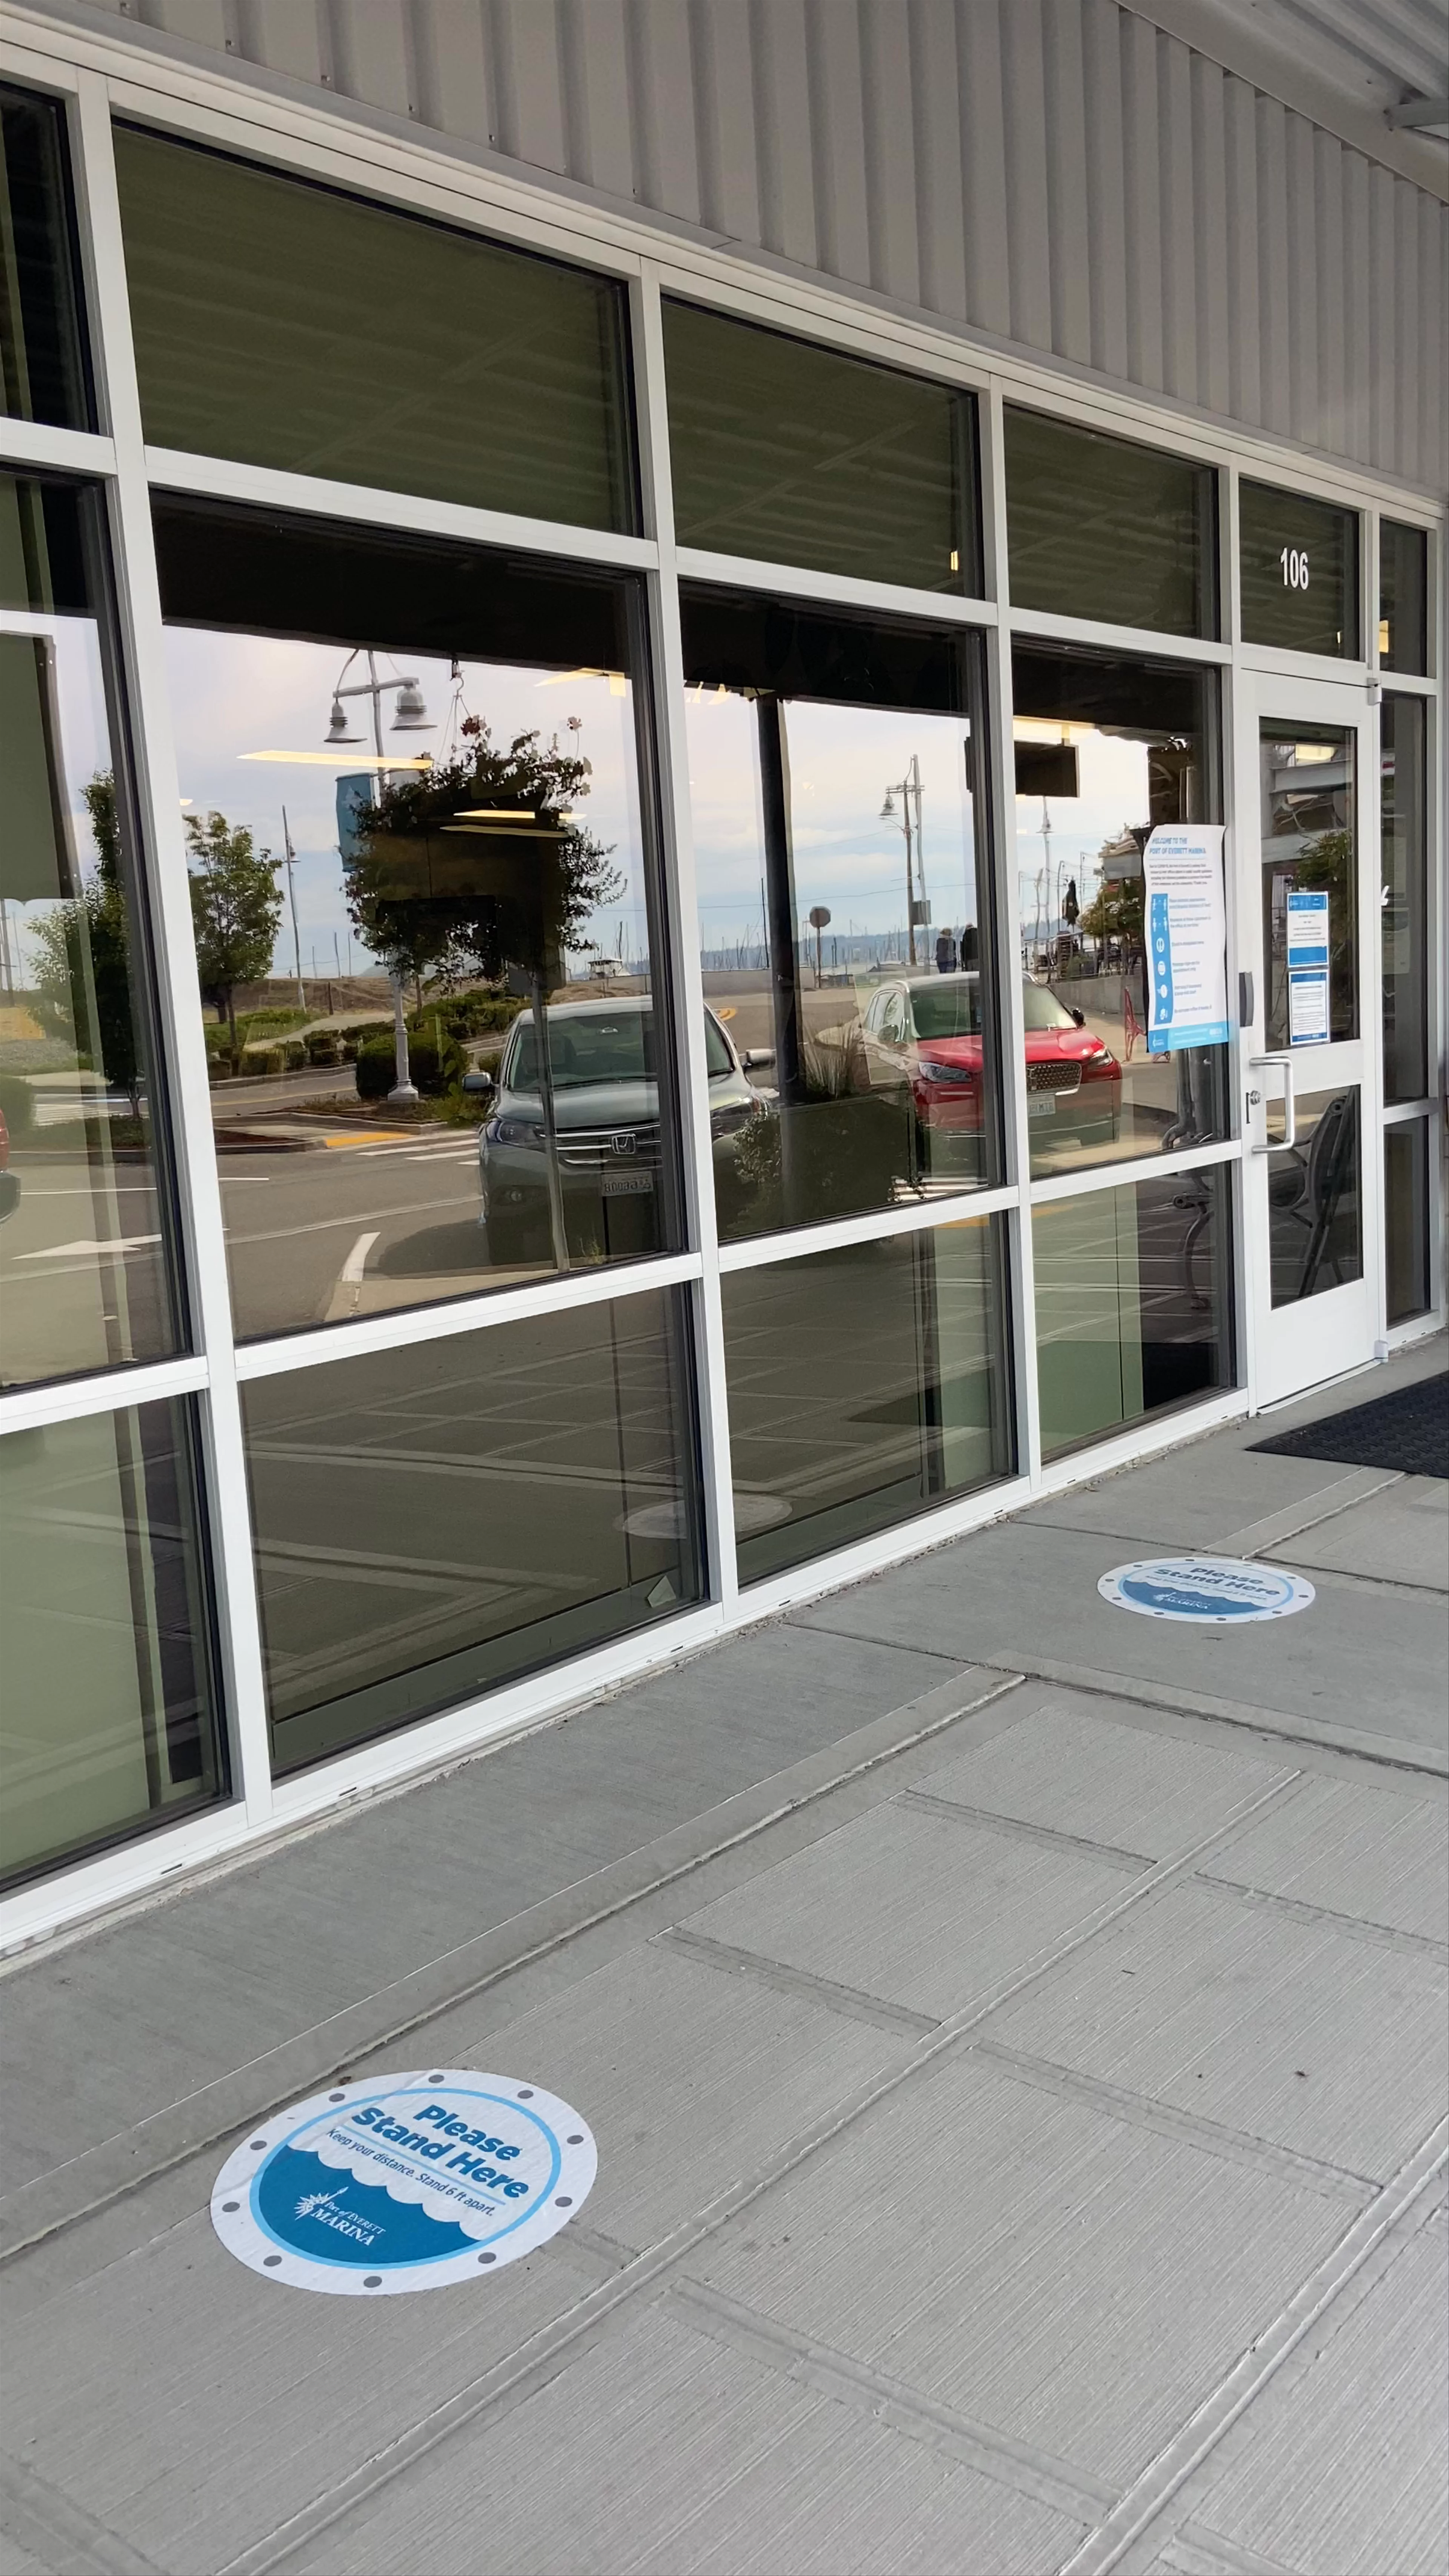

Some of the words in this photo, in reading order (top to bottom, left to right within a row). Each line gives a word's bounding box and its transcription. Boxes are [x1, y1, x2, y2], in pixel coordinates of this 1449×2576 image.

[1280, 547, 1309, 590] 106
[1154, 1569, 1223, 1584] Stand
[1224, 1581, 1280, 1595] Here
[1190, 1568, 1263, 1584] Please
[413, 2104, 520, 2160] Please
[326, 2128, 353, 2145] Keep
[348, 2142, 375, 2156] your
[372, 2153, 415, 2177] distance.
[415, 2173, 449, 2192] Stand
[454, 2191, 468, 2201] ft
[463, 2198, 496, 2216] apart.
[351, 2107, 456, 2160] Stand
[445, 2152, 529, 2198] Here
[310, 2208, 375, 2246] MARINA
[324, 2201, 340, 2212] Port
[347, 2213, 386, 2234] EVERETT
